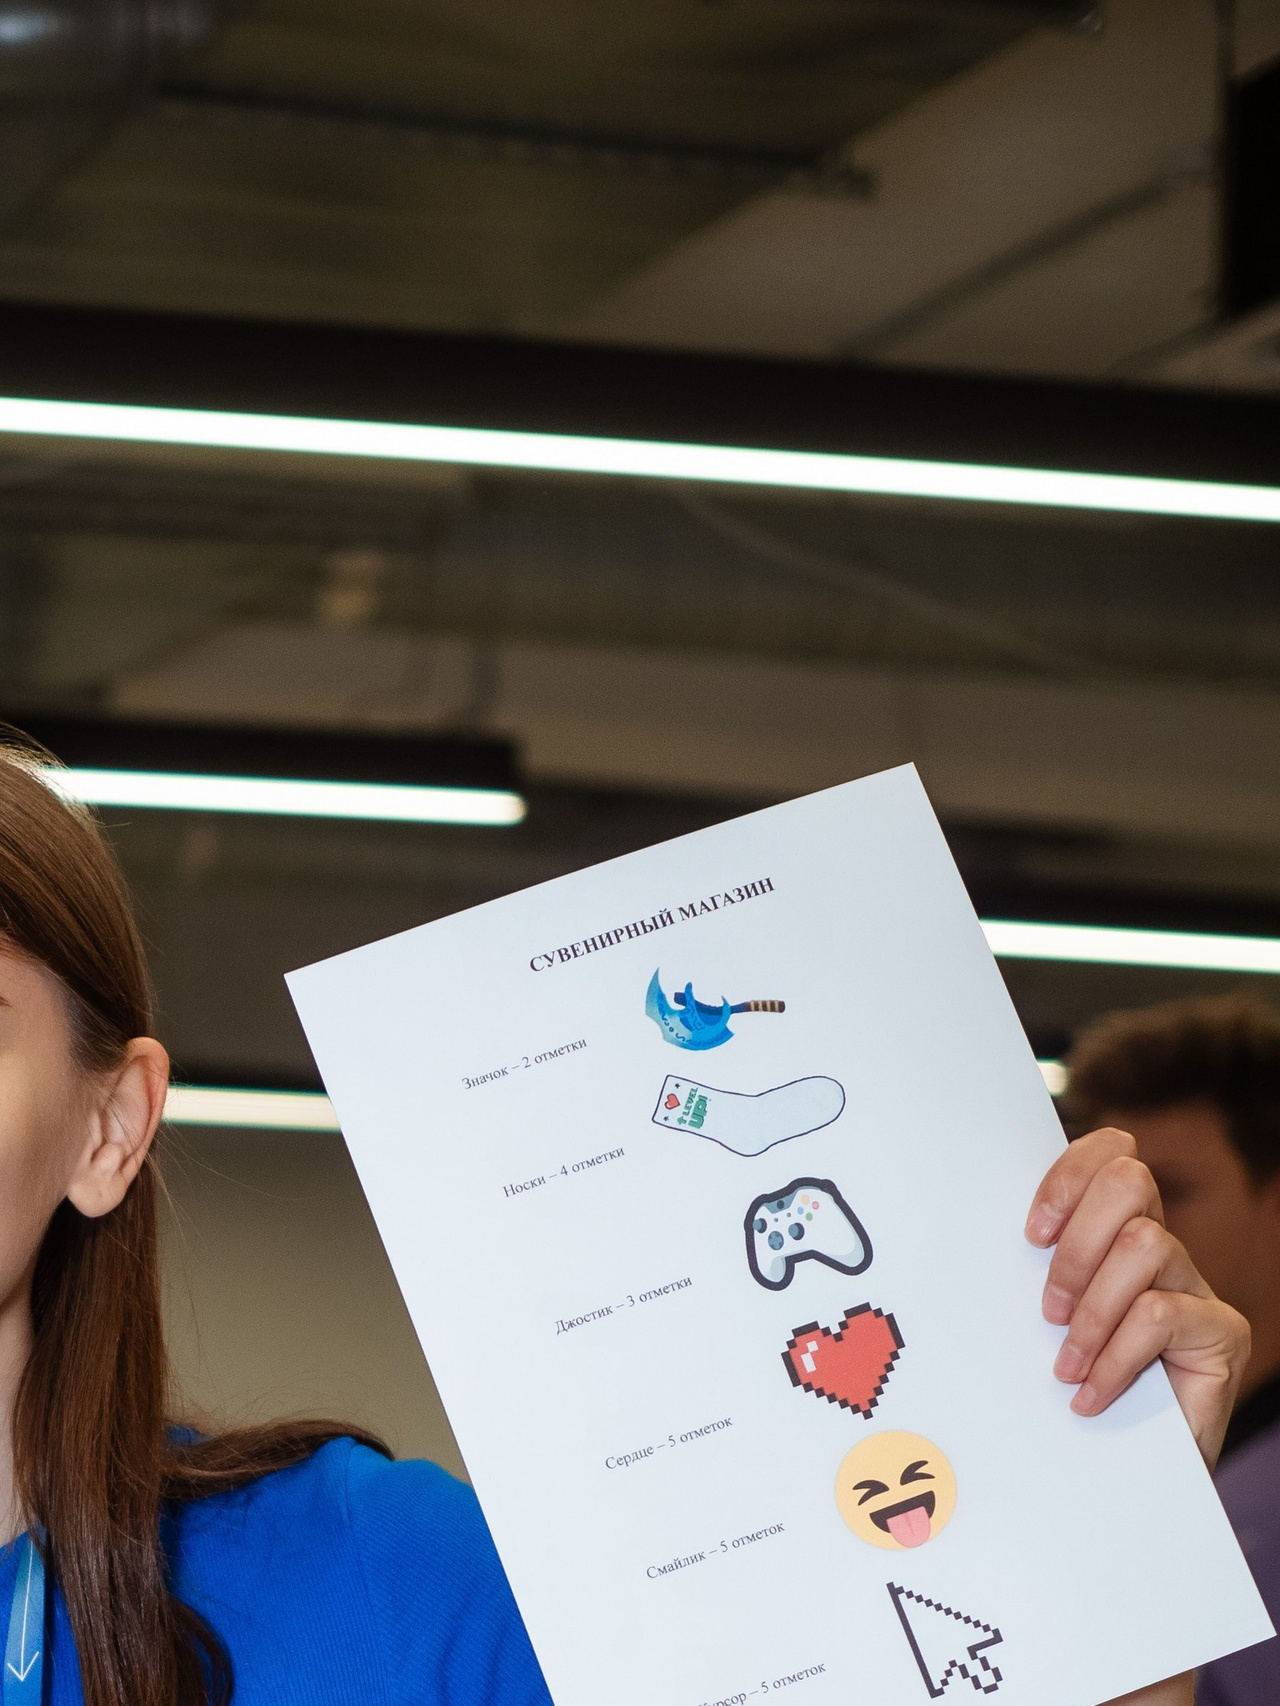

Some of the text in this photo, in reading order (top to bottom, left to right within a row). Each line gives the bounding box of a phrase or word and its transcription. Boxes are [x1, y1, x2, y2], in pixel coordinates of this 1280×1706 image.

[529, 876, 776, 972] СУВЕНИРНЫЙ МАГАЗИН
[461, 1066, 510, 1090] Значок
[521, 1056, 532, 1069] 2
[534, 1038, 588, 1064] отметки
[682, 1087, 698, 1116] LEVEL
[688, 1094, 711, 1129] UP!
[502, 1175, 547, 1198] Носки
[560, 1164, 569, 1176] 4
[571, 1147, 625, 1173] отметки
[555, 1305, 614, 1336] Джостик
[625, 1294, 636, 1308] 3
[638, 1277, 693, 1303] отметки
[605, 1446, 655, 1470] Сердце
[668, 1434, 676, 1448] 5
[679, 1417, 734, 1443] отметок
[646, 1551, 707, 1579] Смайлик
[719, 1540, 728, 1553] 5
[731, 1522, 786, 1549] отметок
[760, 1680, 769, 1694] 5
[772, 1663, 827, 1690] отметок
